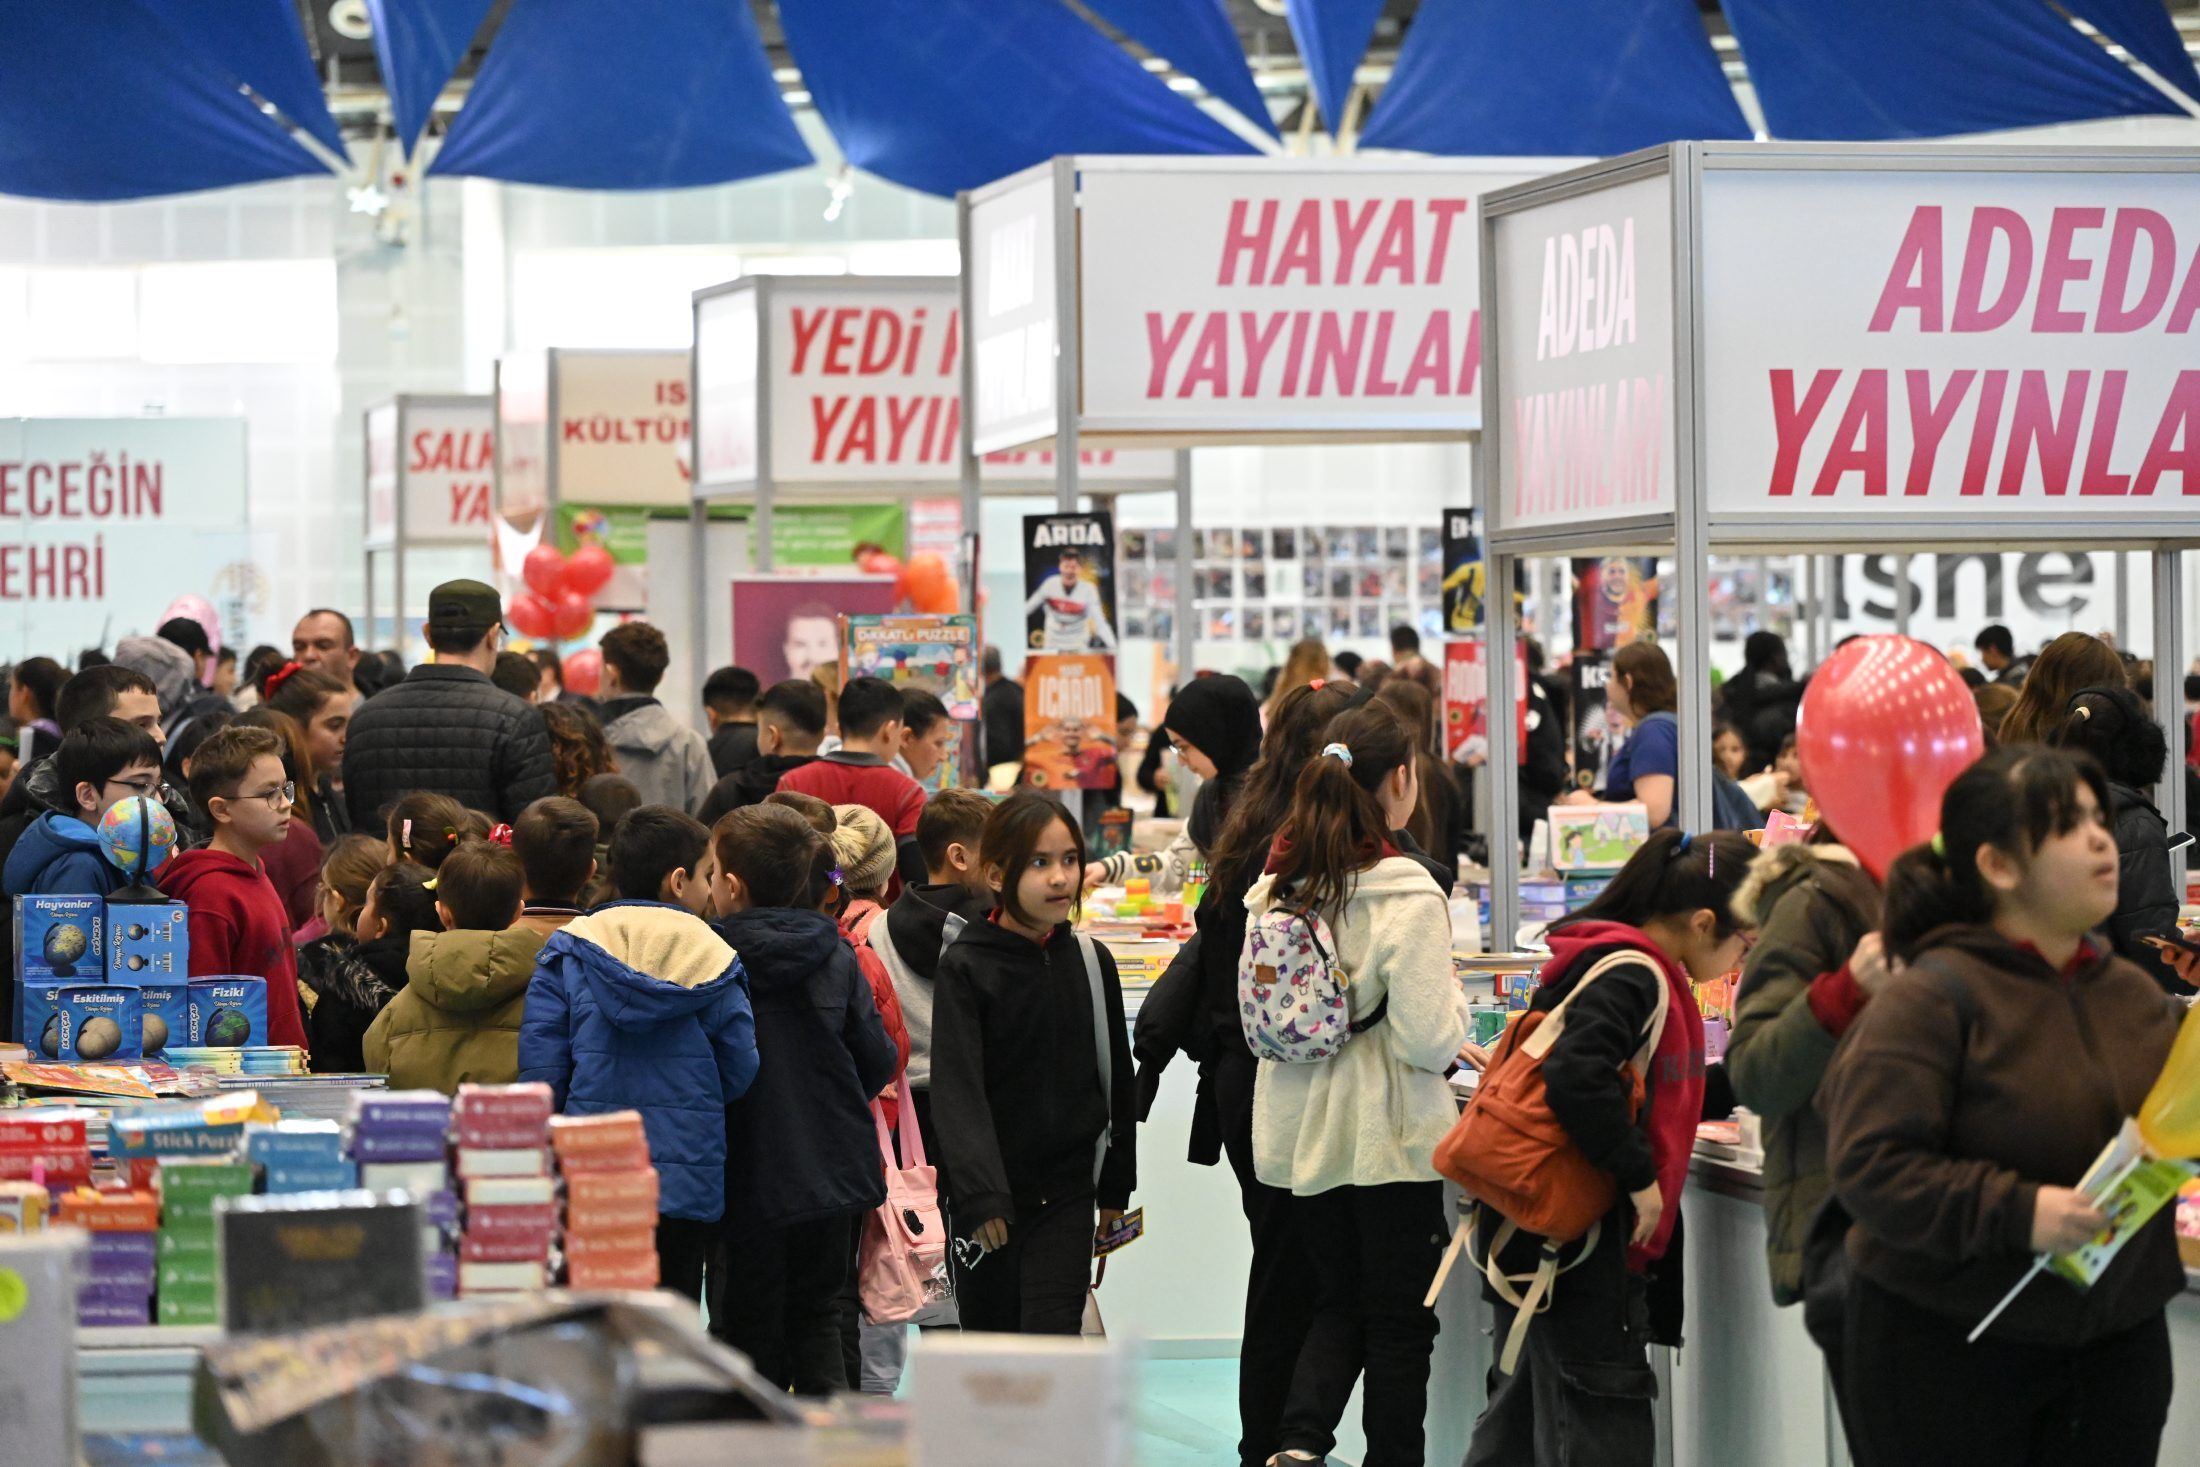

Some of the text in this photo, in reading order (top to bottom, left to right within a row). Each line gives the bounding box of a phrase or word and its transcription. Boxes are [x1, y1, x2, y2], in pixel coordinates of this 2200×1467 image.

[1217, 199, 1467, 286] HAYAT
[1536, 216, 1636, 362] ADEDA
[1514, 371, 1664, 517] YAYINLARI
[36, 900, 93, 911] Hayvanlar
[73, 994, 126, 1004] Eskitilmiş
[212, 987, 245, 997] Fiziki
[153, 1132, 194, 1149] Stick
